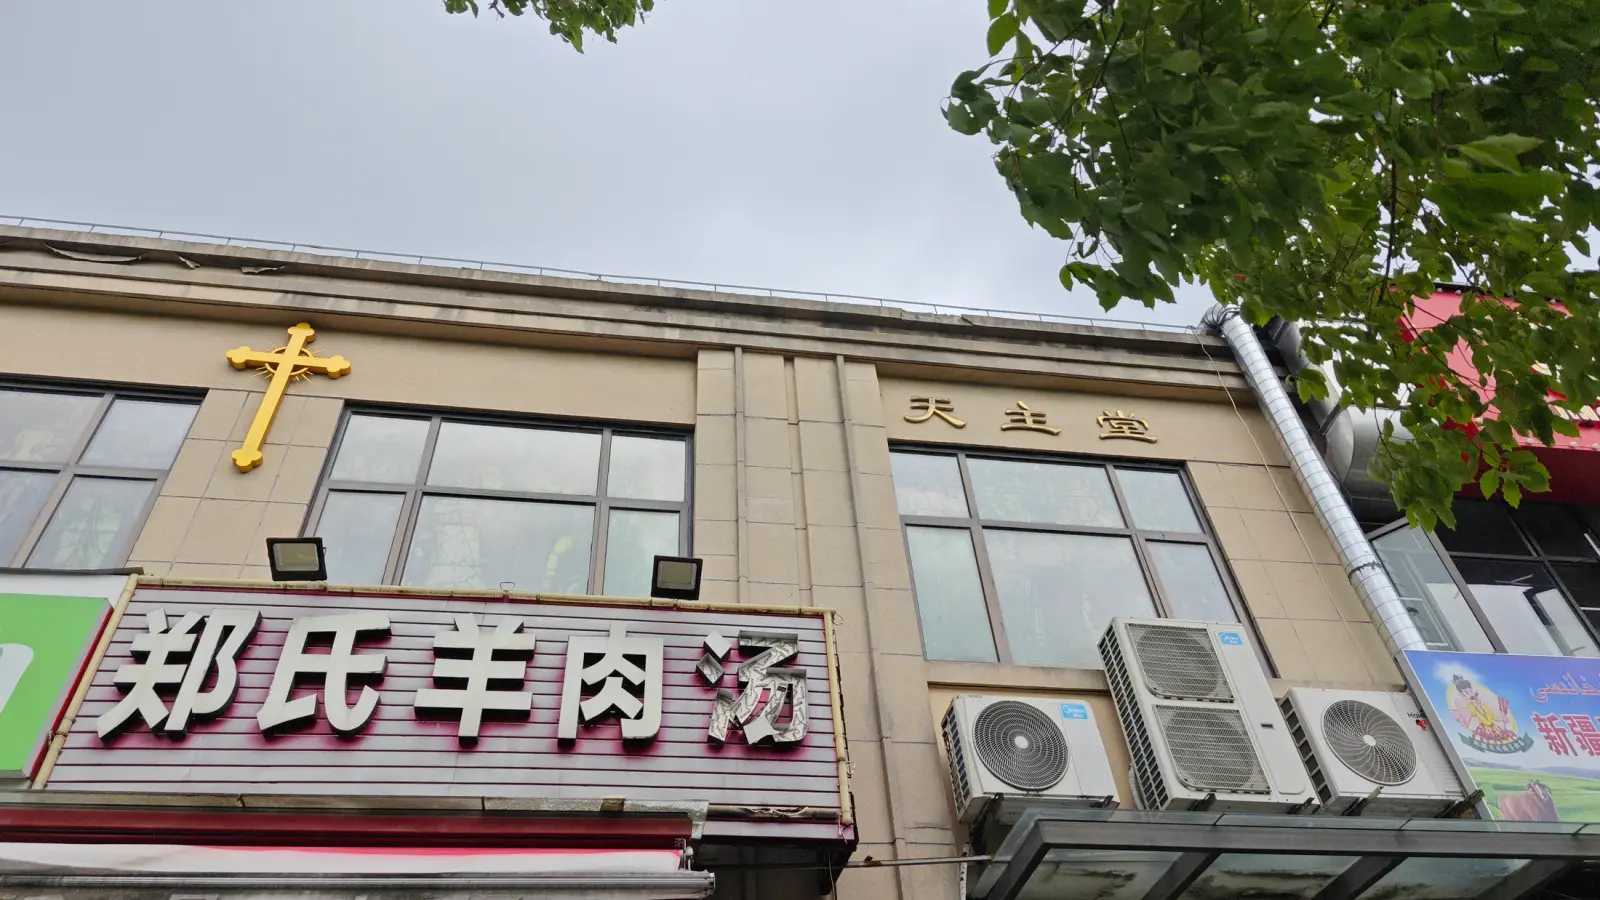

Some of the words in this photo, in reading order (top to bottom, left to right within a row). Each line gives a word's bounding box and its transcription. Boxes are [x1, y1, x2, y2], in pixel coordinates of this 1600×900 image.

[903, 396, 1158, 443] 天主堂
[96, 608, 808, 746] 郑氏羊肉汤
[1531, 712, 1600, 757] 新疆
